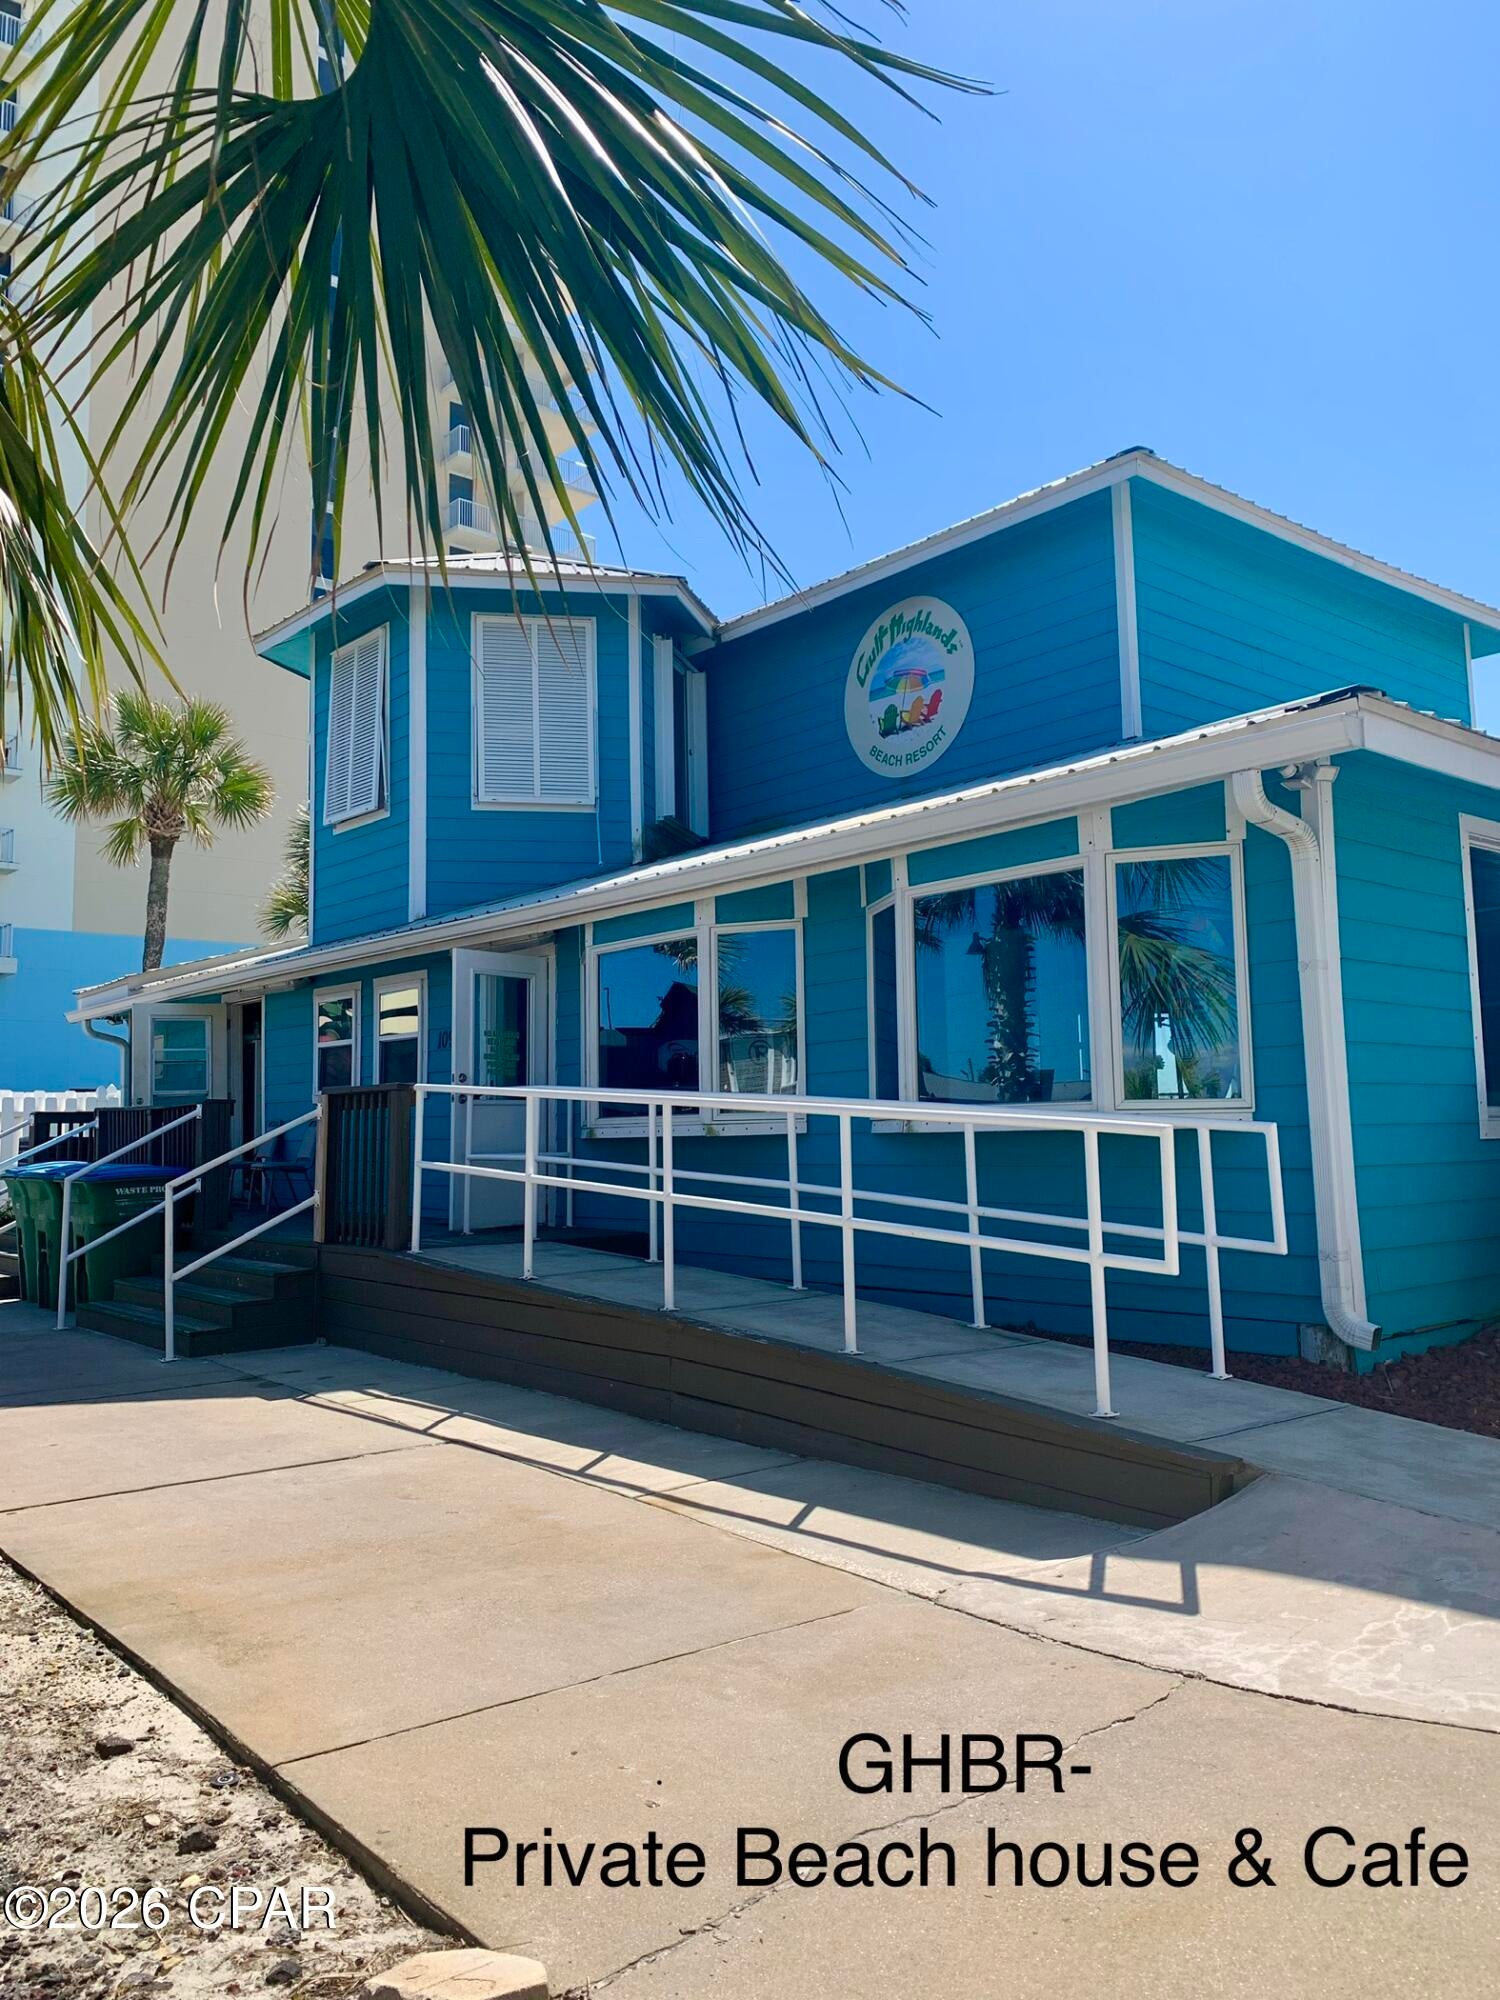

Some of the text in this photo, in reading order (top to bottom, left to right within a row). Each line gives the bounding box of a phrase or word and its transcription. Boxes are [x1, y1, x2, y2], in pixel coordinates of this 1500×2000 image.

[856, 609, 958, 688] Gulf Highlands
[869, 725, 947, 767] BEACH RESORT
[115, 1187, 148, 1195] WASTE
